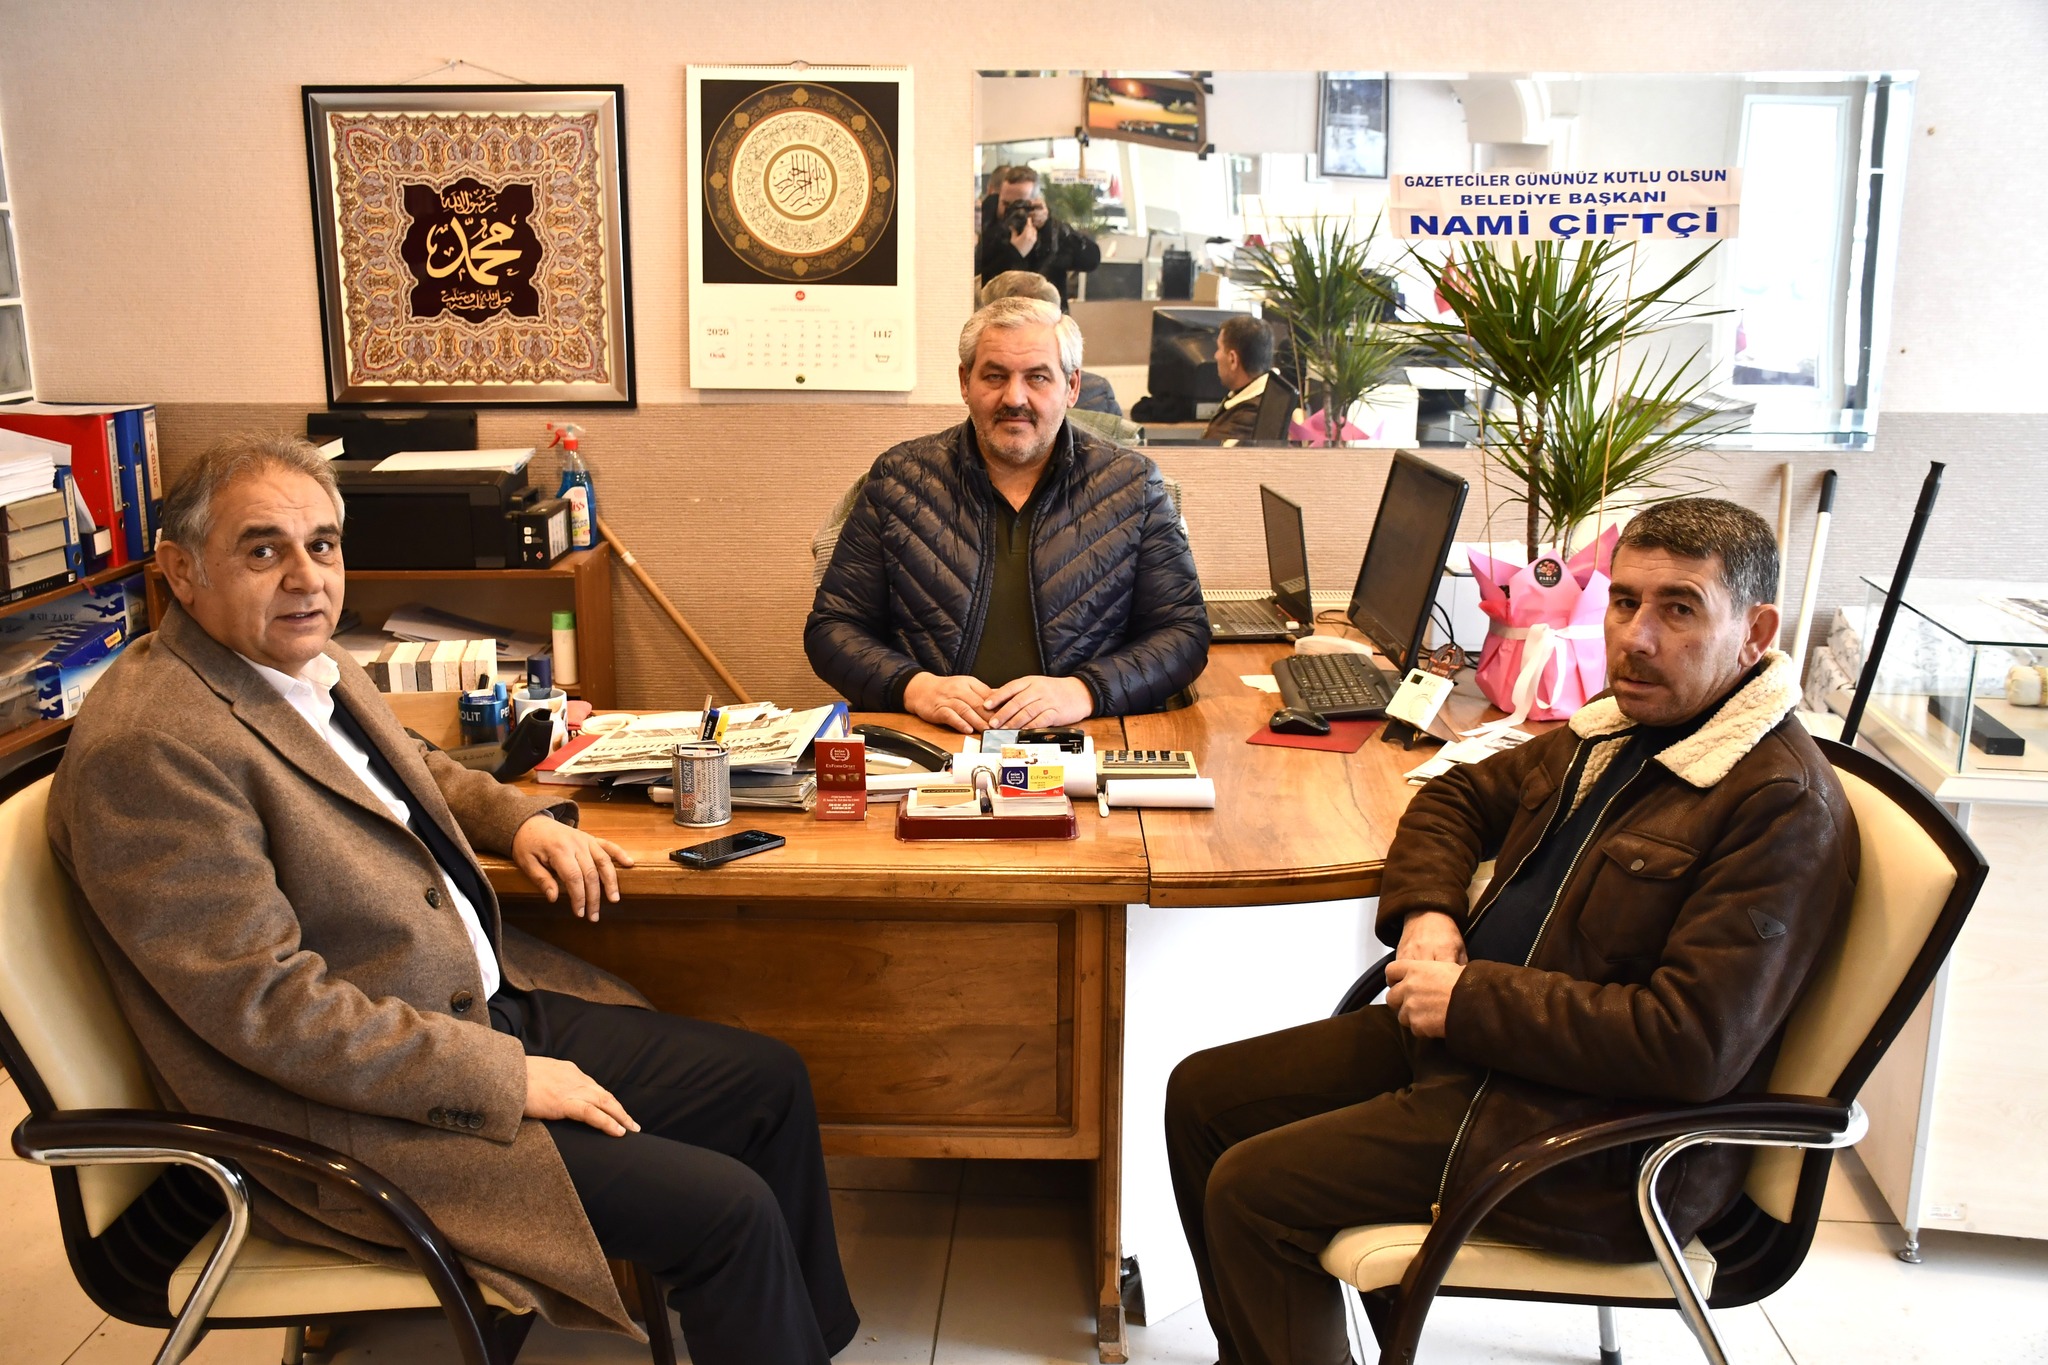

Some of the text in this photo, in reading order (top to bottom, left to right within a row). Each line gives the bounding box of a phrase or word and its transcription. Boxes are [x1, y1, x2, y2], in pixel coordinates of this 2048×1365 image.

[1404, 170, 1727, 187] GAZETECİLER GÜNÜNÜZ KUTLU OLSUN
[1461, 191, 1666, 206] BELEDİYE BAŞKANI
[1410, 207, 1718, 240] NAMİ ÇİFTÇİ
[706, 328, 729, 336] 2026
[148, 430, 160, 489] HABER
